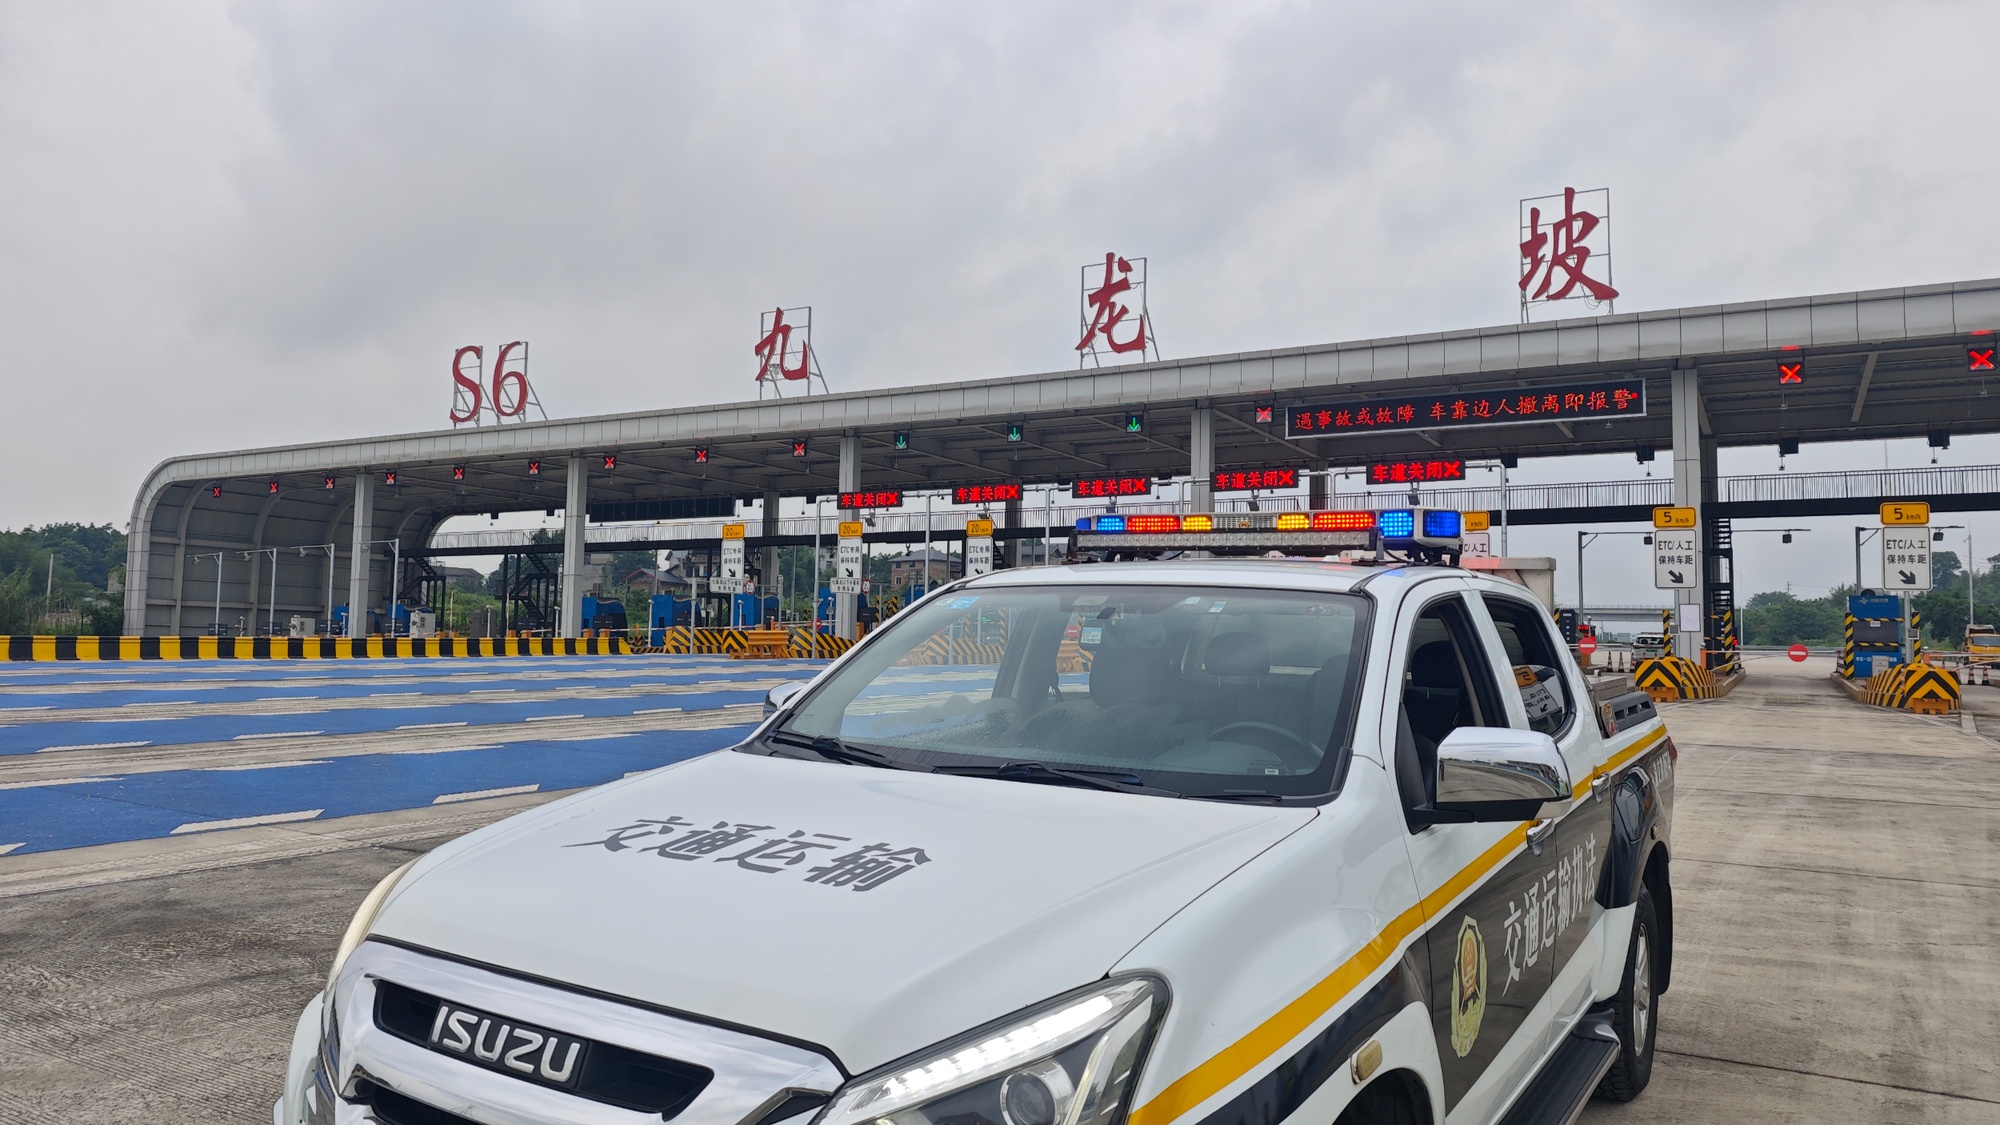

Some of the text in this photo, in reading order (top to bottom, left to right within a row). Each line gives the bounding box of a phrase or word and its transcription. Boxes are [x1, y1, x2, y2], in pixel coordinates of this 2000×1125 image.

[449, 340, 528, 423] S6
[1372, 461, 1444, 482] 车道关闭
[1215, 470, 1278, 490] 车道关闭
[956, 486, 1006, 503] 车道关闭
[1077, 479, 1132, 497] 车道关闭
[841, 492, 887, 508] 车道关闭
[1664, 511, 1673, 523] 5
[1894, 507, 1903, 521] 5
[726, 528, 734, 536] 20
[843, 525, 851, 534] 20
[971, 523, 980, 533] 20
[1658, 540, 1694, 551] ETC/人工
[1886, 539, 1927, 550] ETC/人工
[1658, 554, 1694, 565] 保持车距
[1886, 554, 1927, 565] 保持车距
[560, 816, 932, 892] 交通运输
[1502, 832, 1597, 997] 交通运输执法
[430, 1005, 581, 1083] ISUZU
